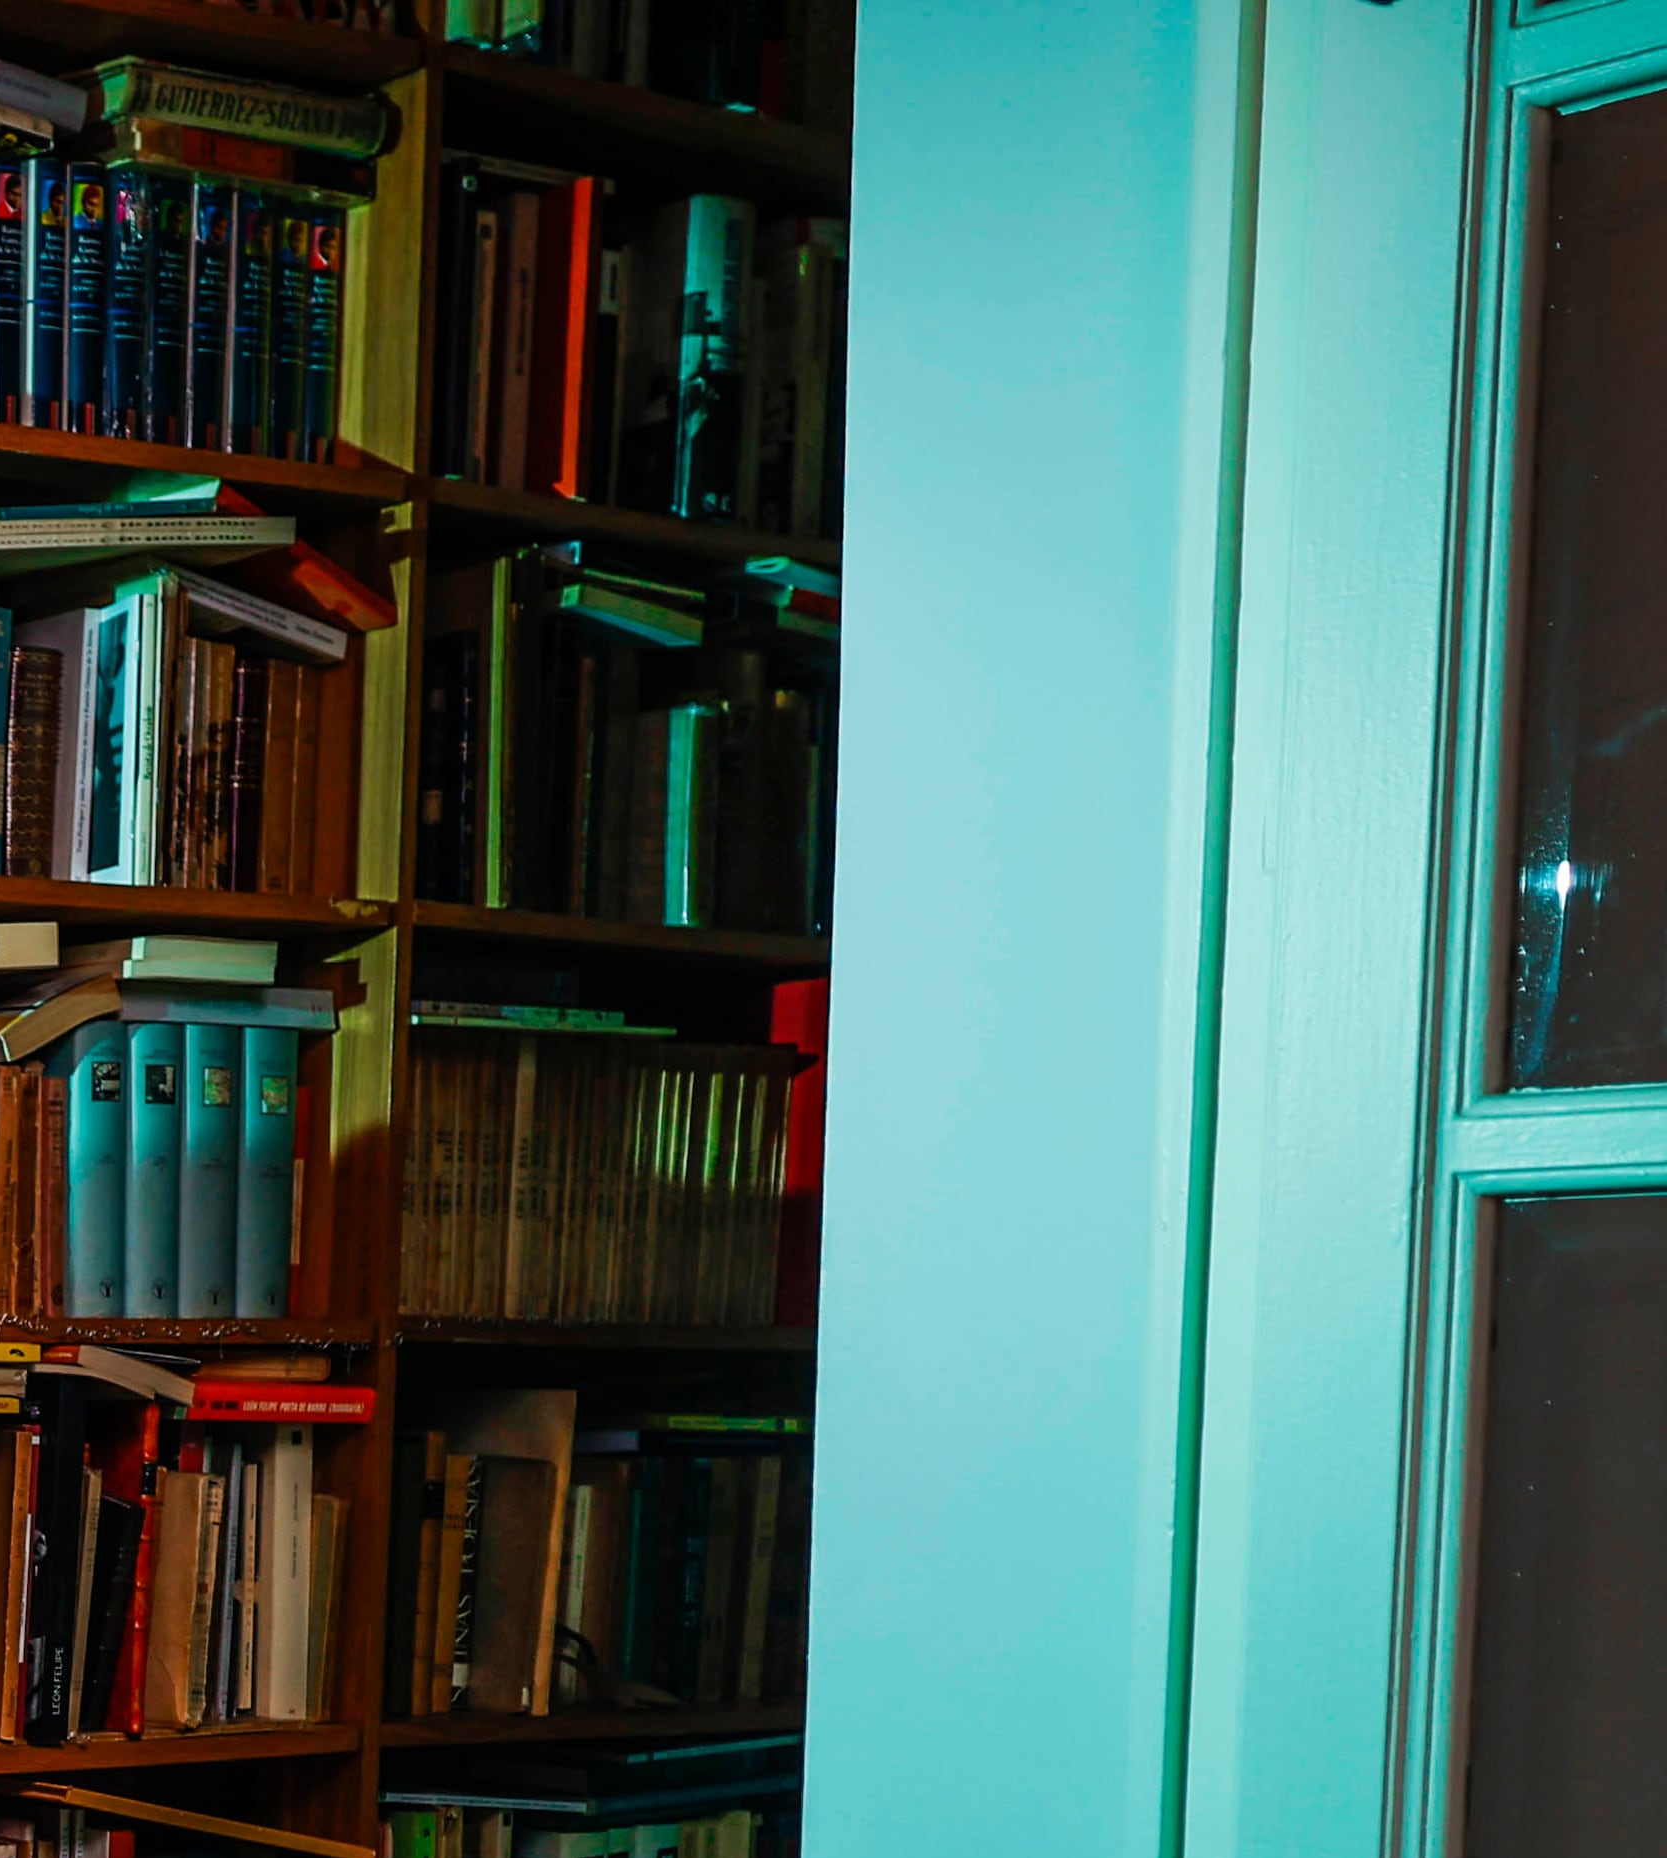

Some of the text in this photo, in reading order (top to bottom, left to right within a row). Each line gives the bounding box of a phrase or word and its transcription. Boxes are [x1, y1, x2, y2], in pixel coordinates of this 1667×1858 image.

[242, 1399, 258, 1412] LEÓN
[258, 1400, 278, 1412] FELIPE
[53, 1647, 64, 1683] FELIPE
